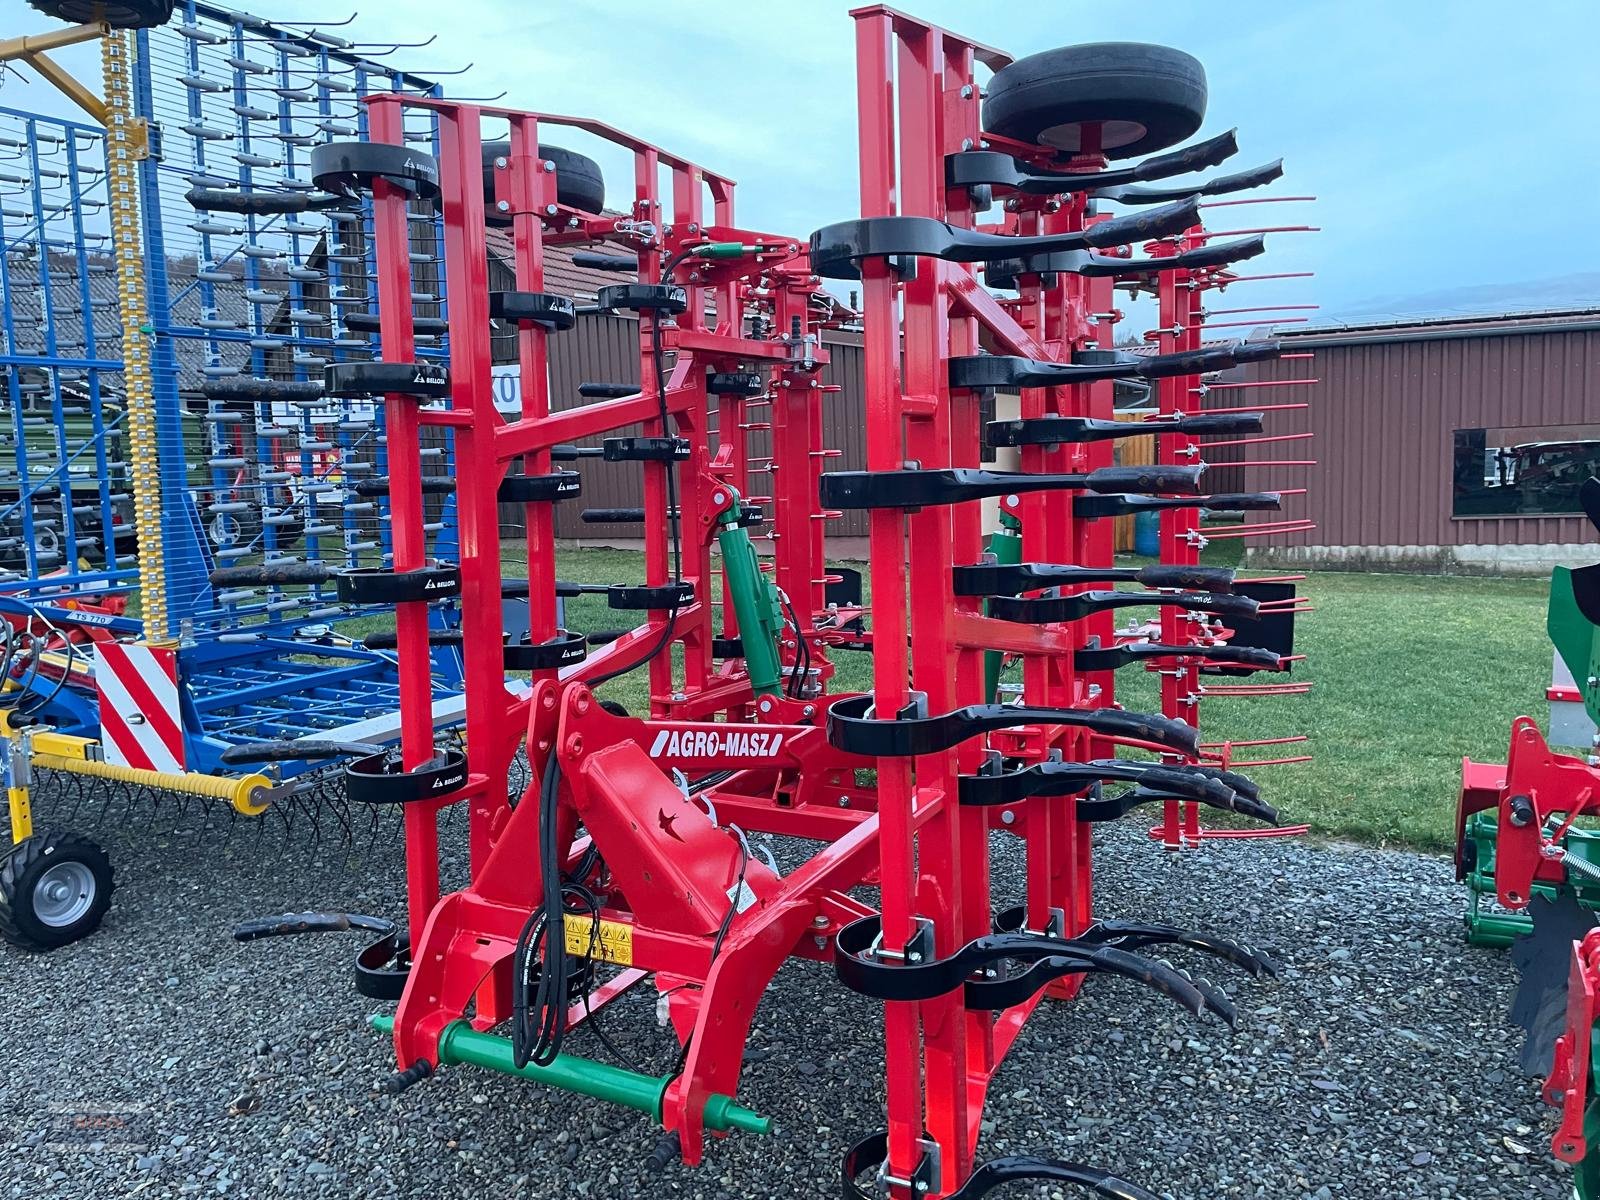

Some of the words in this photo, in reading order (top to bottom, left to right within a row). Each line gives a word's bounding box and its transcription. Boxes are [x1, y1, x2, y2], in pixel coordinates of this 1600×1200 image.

[416, 163, 435, 175] BELLOTA
[426, 377, 445, 385] BELLOTA
[436, 580, 455, 588] BELLOTA
[76, 613, 87, 621] TS
[90, 615, 106, 624] 770
[666, 730, 769, 757] AGRO-MASZ
[444, 774, 463, 786] BELLOTA
